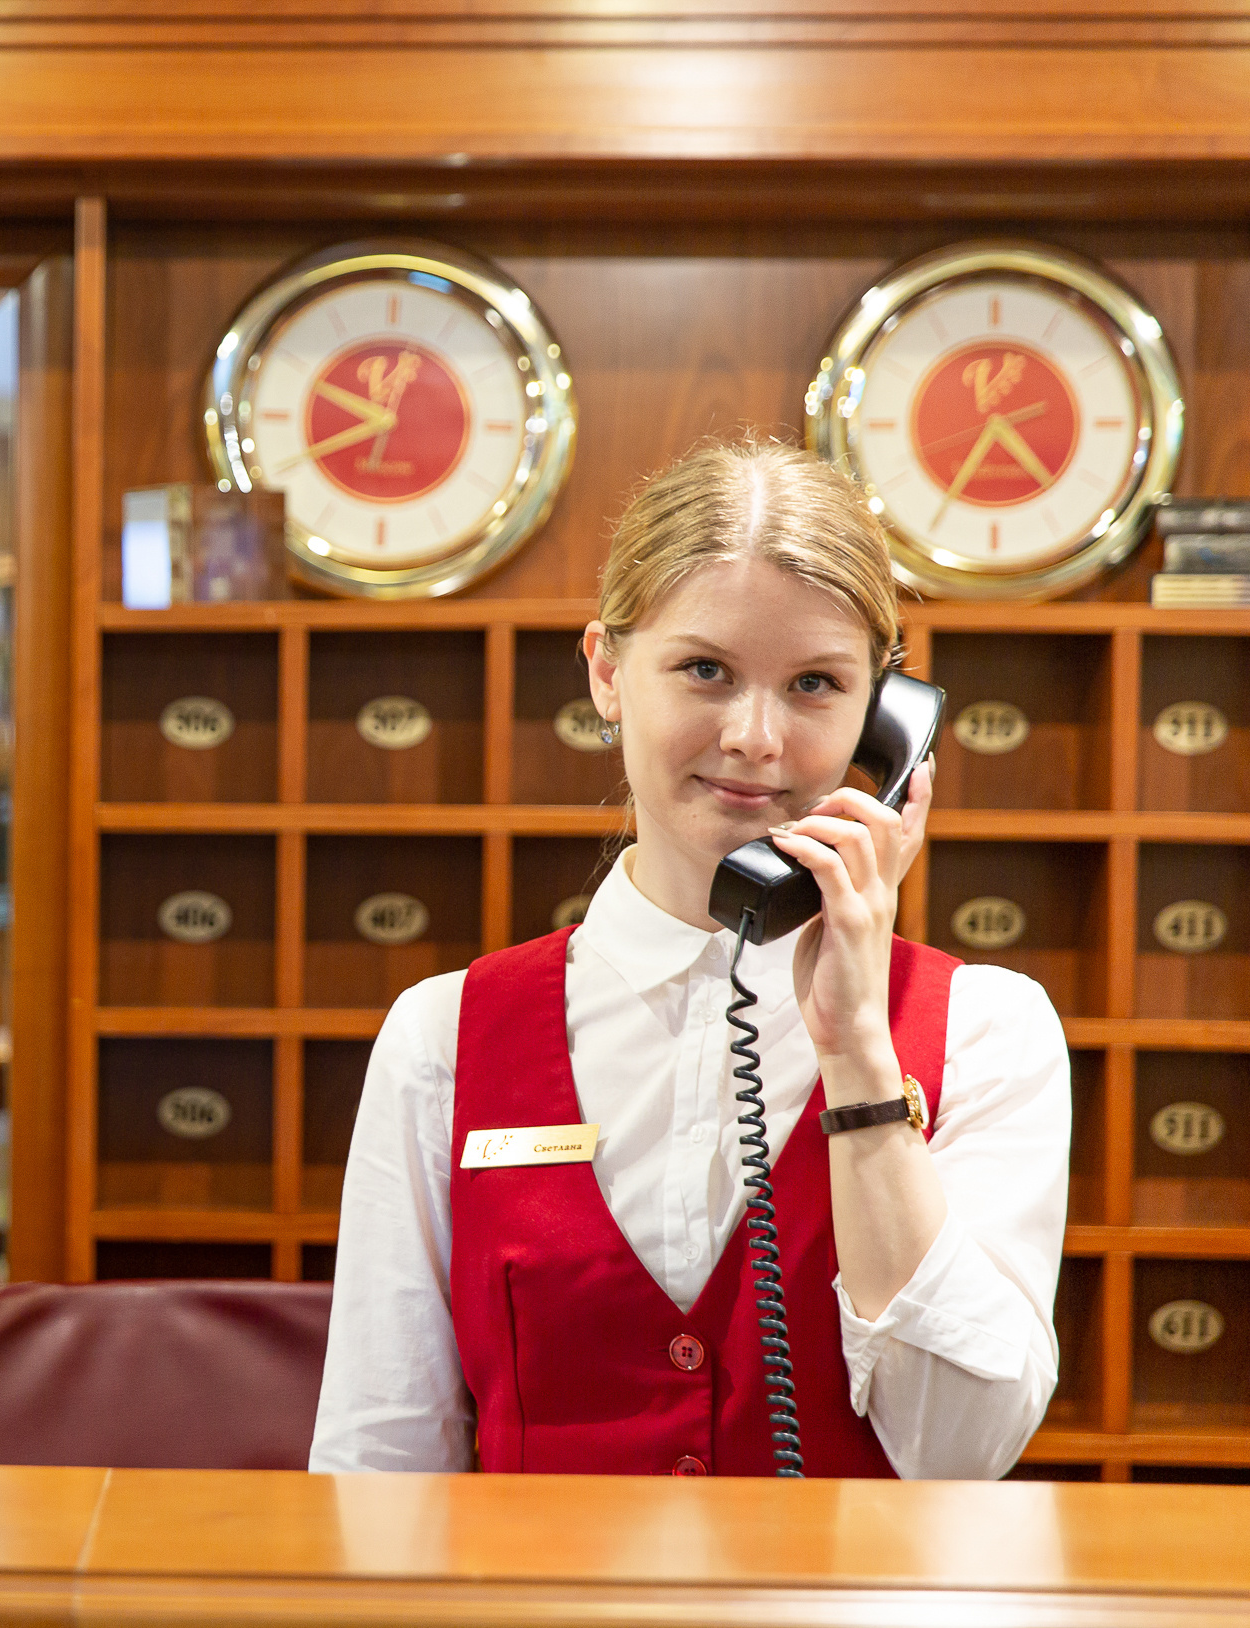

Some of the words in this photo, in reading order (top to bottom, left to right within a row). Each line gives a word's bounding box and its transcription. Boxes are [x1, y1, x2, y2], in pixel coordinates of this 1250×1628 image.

[967, 907, 1015, 934] 410
[1169, 910, 1213, 939] 411
[1165, 1111, 1210, 1140] 511
[533, 1143, 583, 1153] Светлана
[1161, 1310, 1209, 1339] 611
